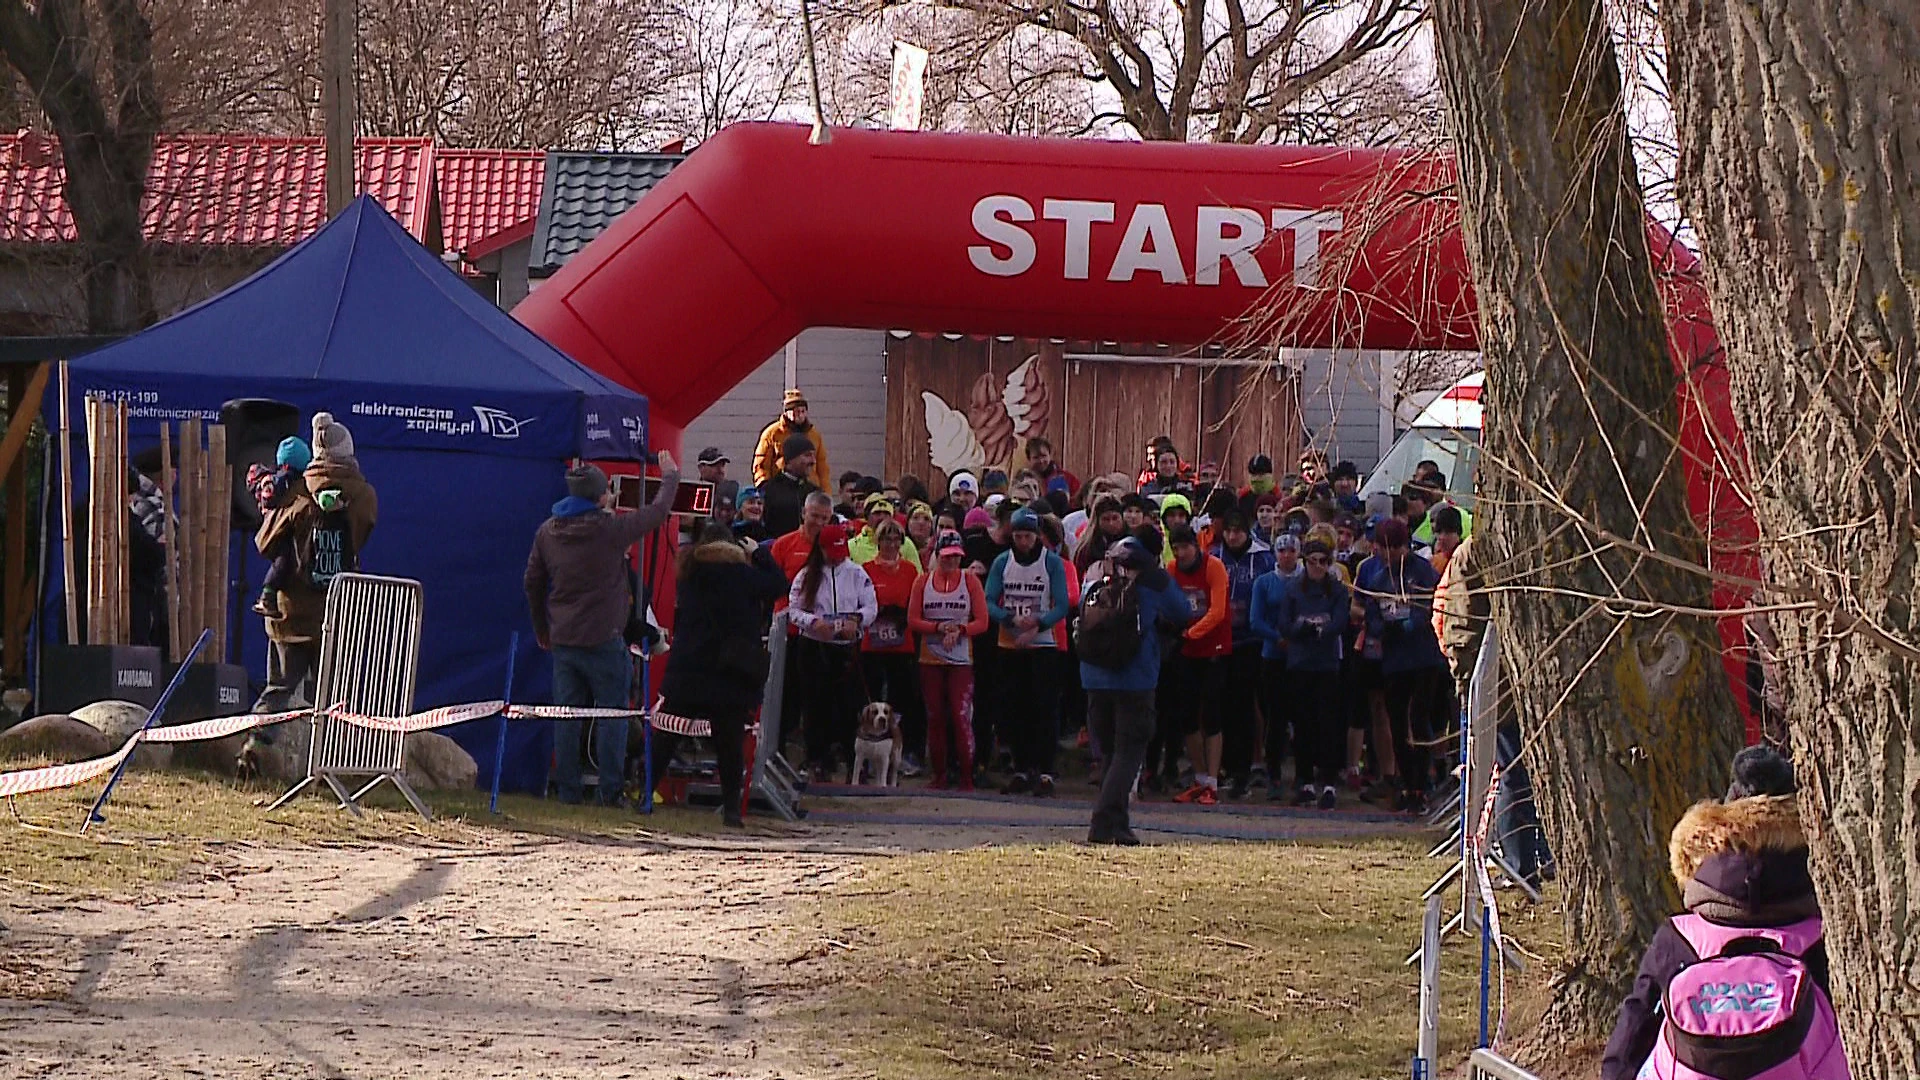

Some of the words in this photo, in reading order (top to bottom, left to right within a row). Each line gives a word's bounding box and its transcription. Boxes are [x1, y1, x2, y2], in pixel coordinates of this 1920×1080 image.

[967, 194, 1343, 288] START
[352, 402, 453, 419] elektroniczne
[406, 417, 475, 435] zapisy.pl
[879, 626, 897, 640] 66
[1690, 996, 1778, 1015] WAVE
